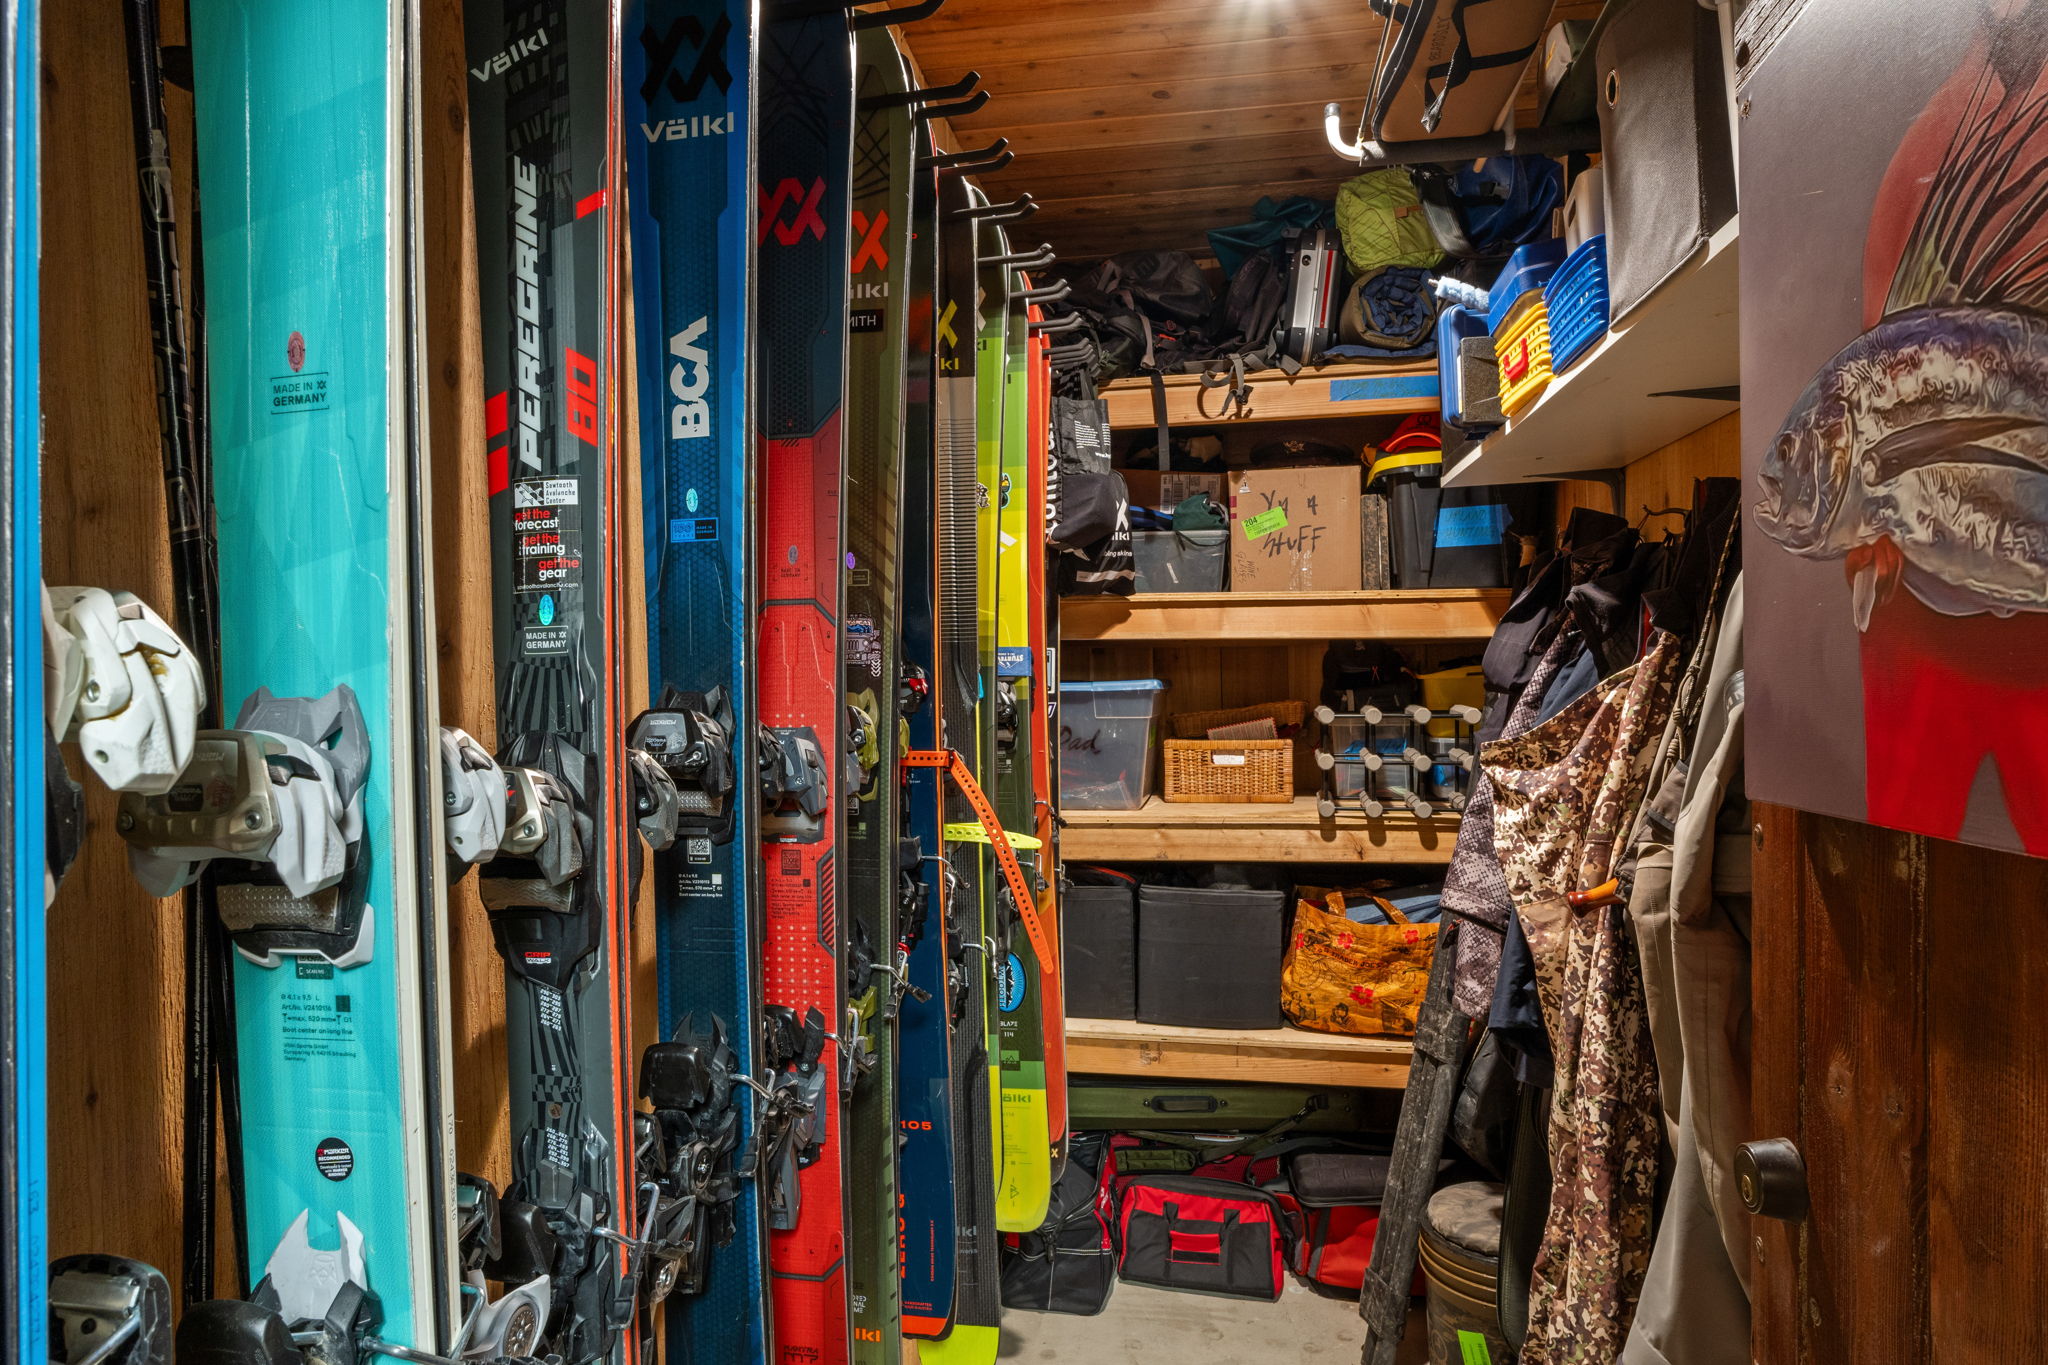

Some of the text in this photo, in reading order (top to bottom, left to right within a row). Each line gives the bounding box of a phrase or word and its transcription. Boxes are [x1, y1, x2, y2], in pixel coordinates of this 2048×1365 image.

[469, 27, 549, 82] Völkl
[639, 111, 735, 143] Völkl
[850, 282, 888, 298] lkl
[513, 155, 542, 472] PEREGRINE
[849, 315, 876, 327] MITH
[670, 315, 710, 440] BCA
[273, 381, 313, 394] MADE IN
[273, 392, 327, 406] GERMANY
[545, 481, 573, 489] Sawtooth
[515, 508, 551, 522] get the
[515, 516, 559, 530] forecast
[523, 533, 560, 546] get the
[522, 543, 566, 555] training
[538, 557, 579, 571] get the
[538, 569, 567, 581] gear
[526, 631, 556, 640] MADE IN
[526, 640, 567, 649] GERMANY
[1003, 1093, 1031, 1103] ölkl
[901, 1120, 932, 1131] 105
